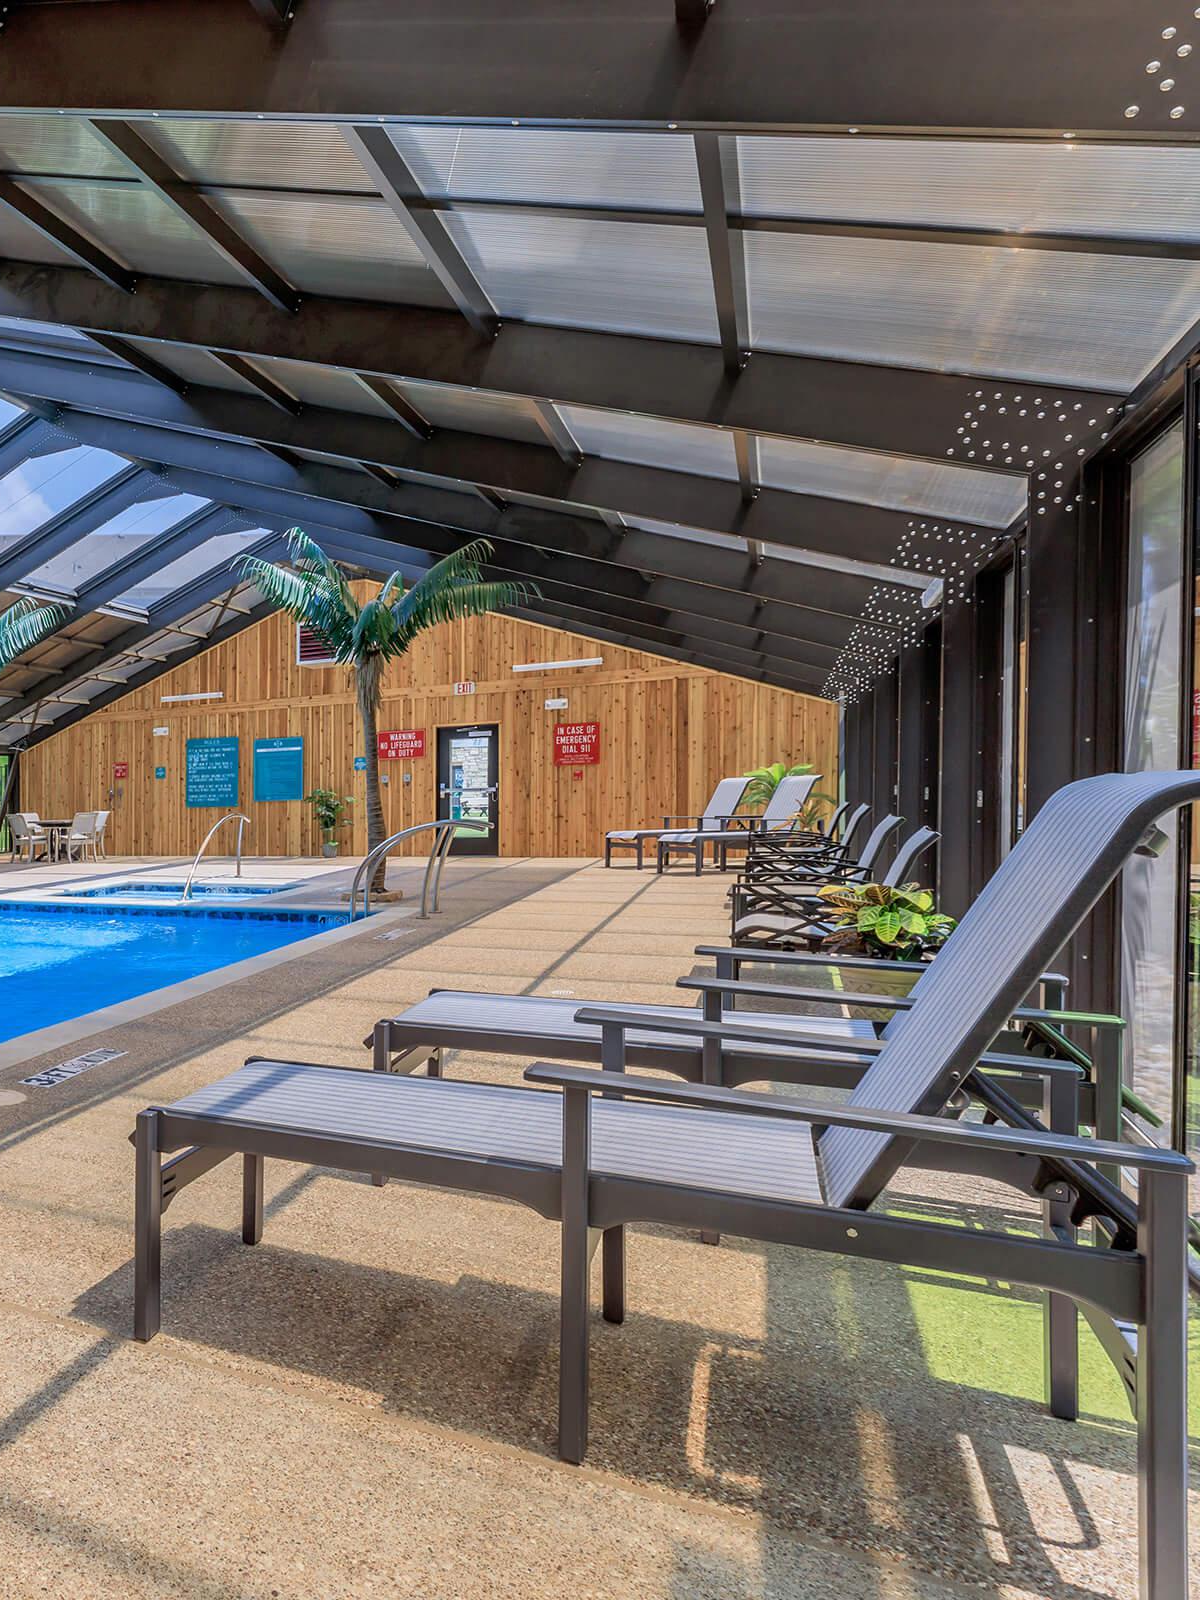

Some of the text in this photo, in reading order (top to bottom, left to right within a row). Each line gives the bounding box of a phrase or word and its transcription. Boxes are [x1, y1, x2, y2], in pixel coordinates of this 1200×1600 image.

[457, 683, 473, 693] EXIT
[557, 725, 596, 735] IN CASE OF
[390, 733, 416, 741] WARNING
[556, 735, 596, 744] EMERGENCY
[391, 740, 422, 749] LIFEGUARD
[562, 744, 591, 753] DIAL 911
[399, 749, 414, 757] DUTY
[41, 1067, 77, 1079] FT
